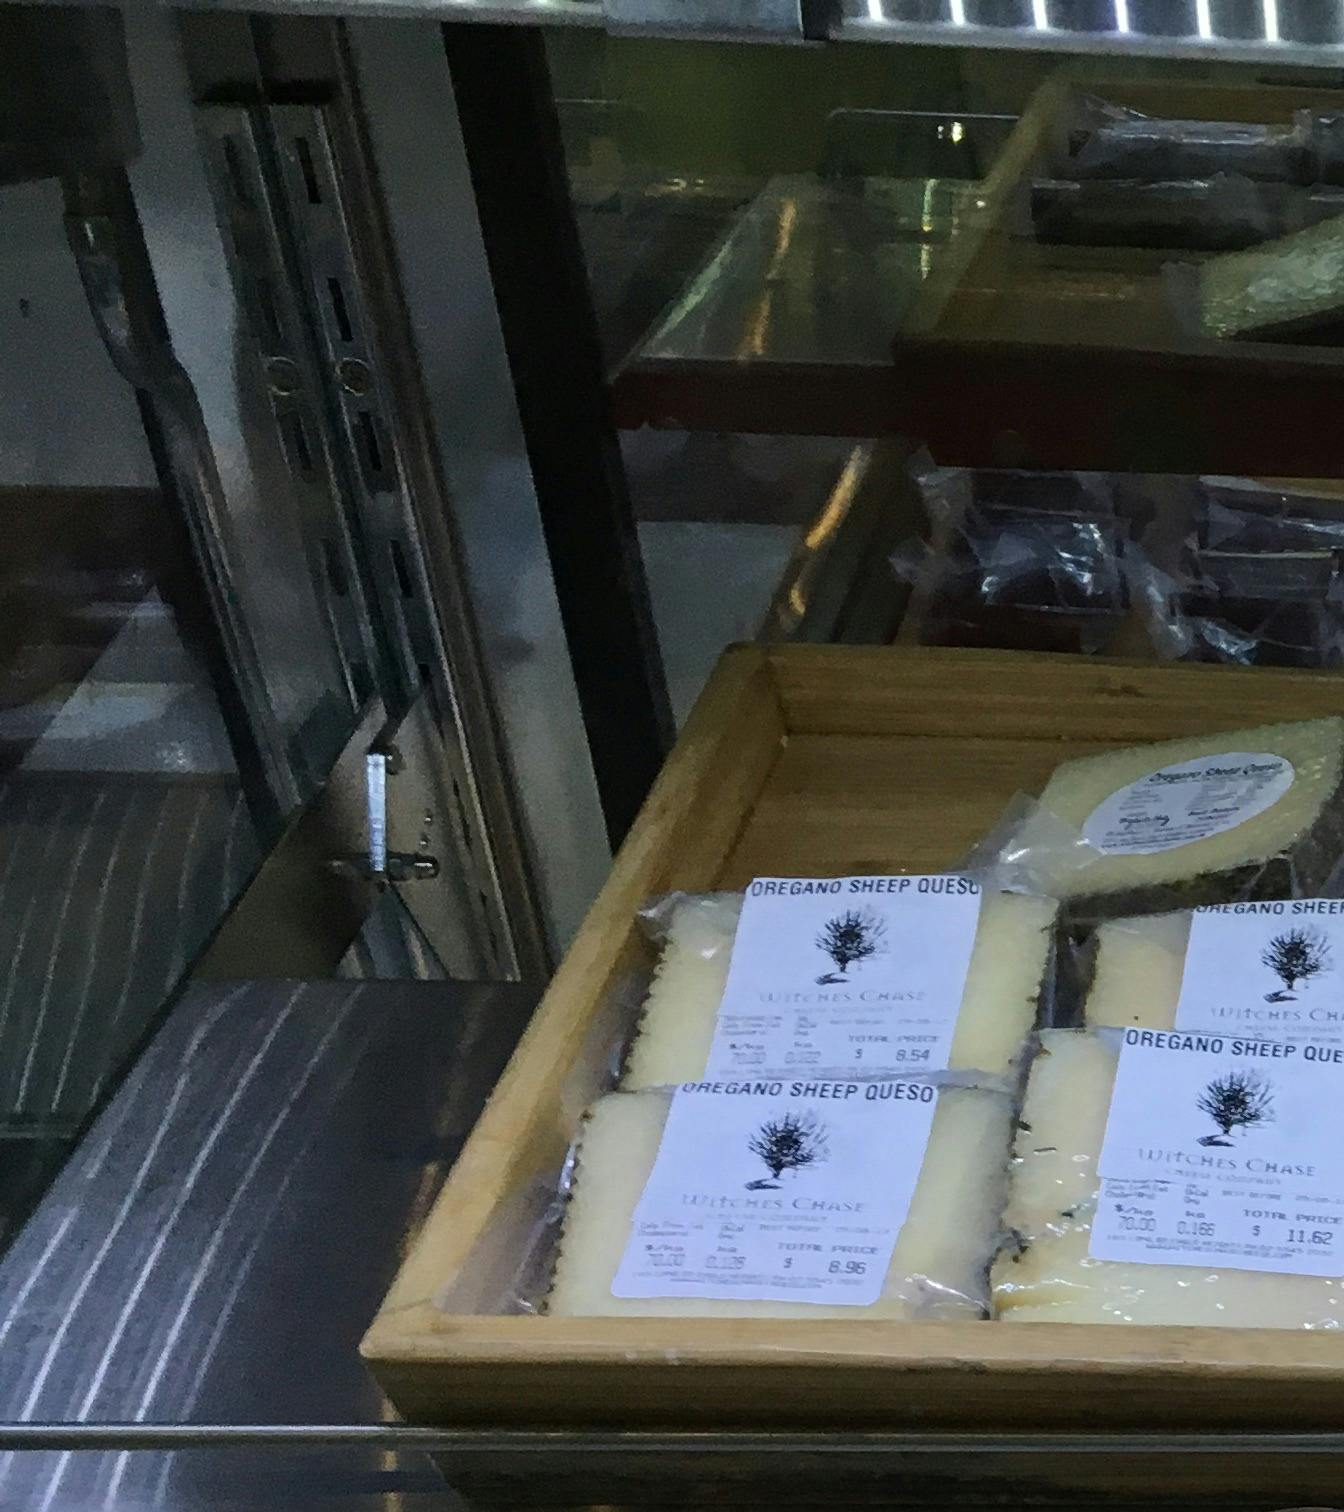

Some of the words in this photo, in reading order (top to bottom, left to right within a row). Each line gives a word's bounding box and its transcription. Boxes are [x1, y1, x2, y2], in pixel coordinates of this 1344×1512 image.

[751, 881, 841, 896] OREGANO
[850, 879, 910, 894] SHEEP
[1196, 902, 1284, 915] OREGANO
[1126, 1030, 1223, 1054] OREGANO
[1232, 1041, 1296, 1058] SHEEP
[682, 1082, 782, 1097] OREGANO
[790, 1083, 858, 1100] SHEEP
[865, 1084, 933, 1103] QUESO
[1288, 1230, 1333, 1245] 11.62
